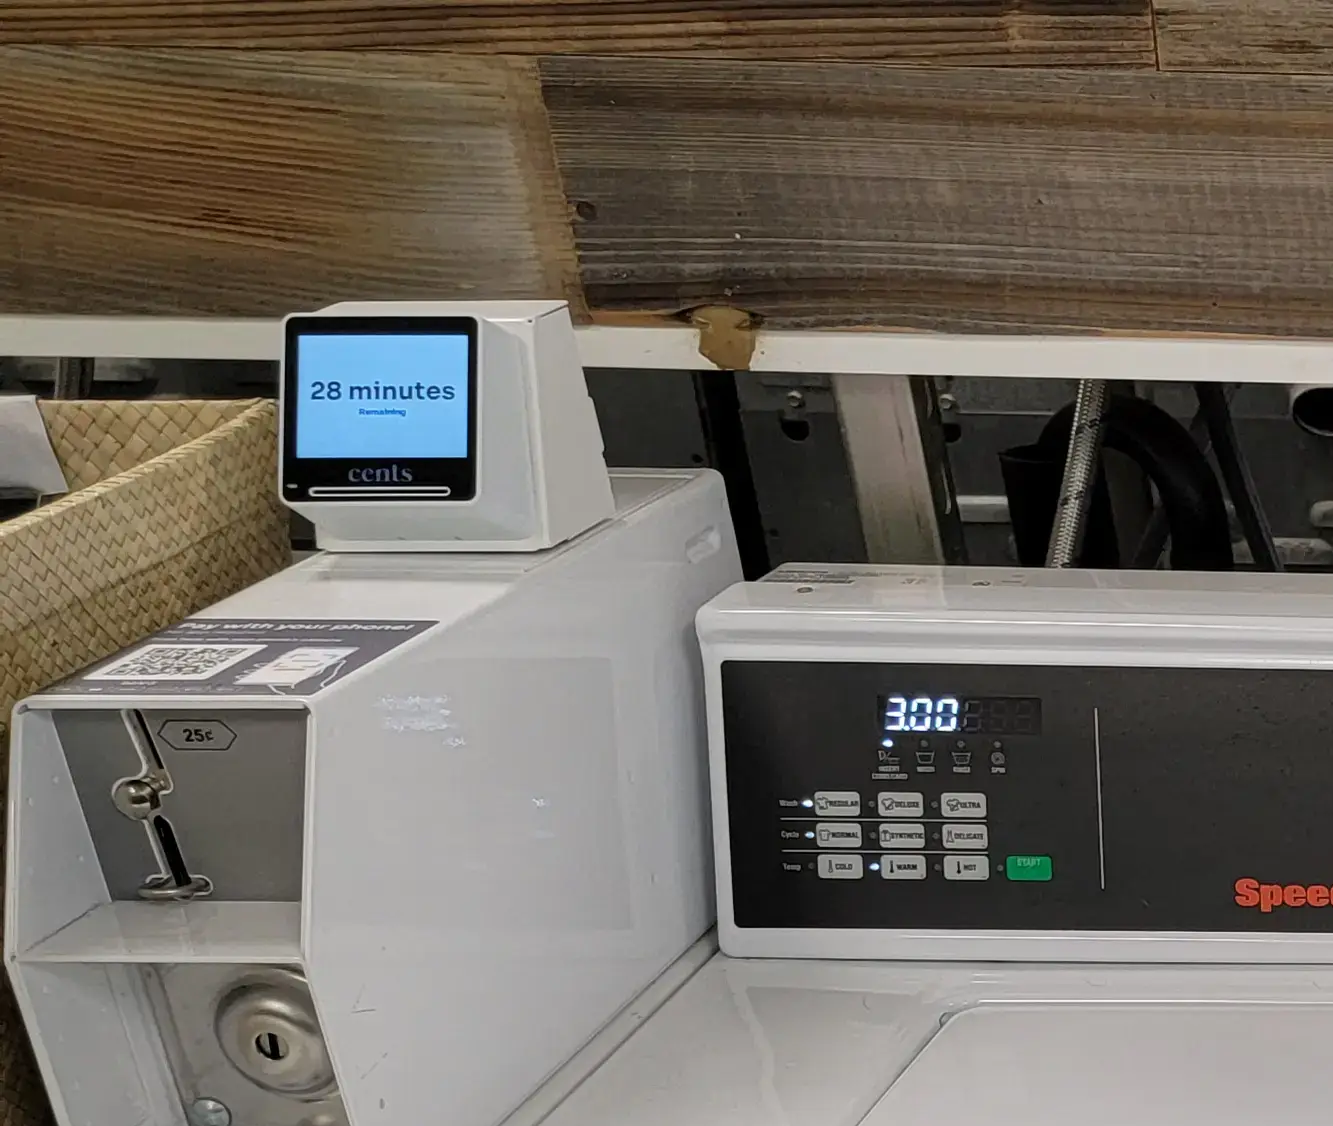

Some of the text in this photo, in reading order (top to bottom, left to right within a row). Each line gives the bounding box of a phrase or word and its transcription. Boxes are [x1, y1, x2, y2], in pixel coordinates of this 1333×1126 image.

[311, 381, 456, 401] 28 minutes
[359, 408, 407, 417] Remaining
[348, 464, 413, 483] cents
[178, 622, 416, 632] Pay with your phone!
[884, 697, 960, 731] 3.00
[182, 728, 215, 743] 25¢
[894, 801, 921, 809] DELUXE
[960, 801, 982, 809] ULTRA
[781, 831, 800, 839] Cycle
[890, 832, 924, 840] SYNTHETIC
[1016, 858, 1042, 868] START
[782, 864, 802, 872] Temp
[963, 864, 977, 872] HOT
